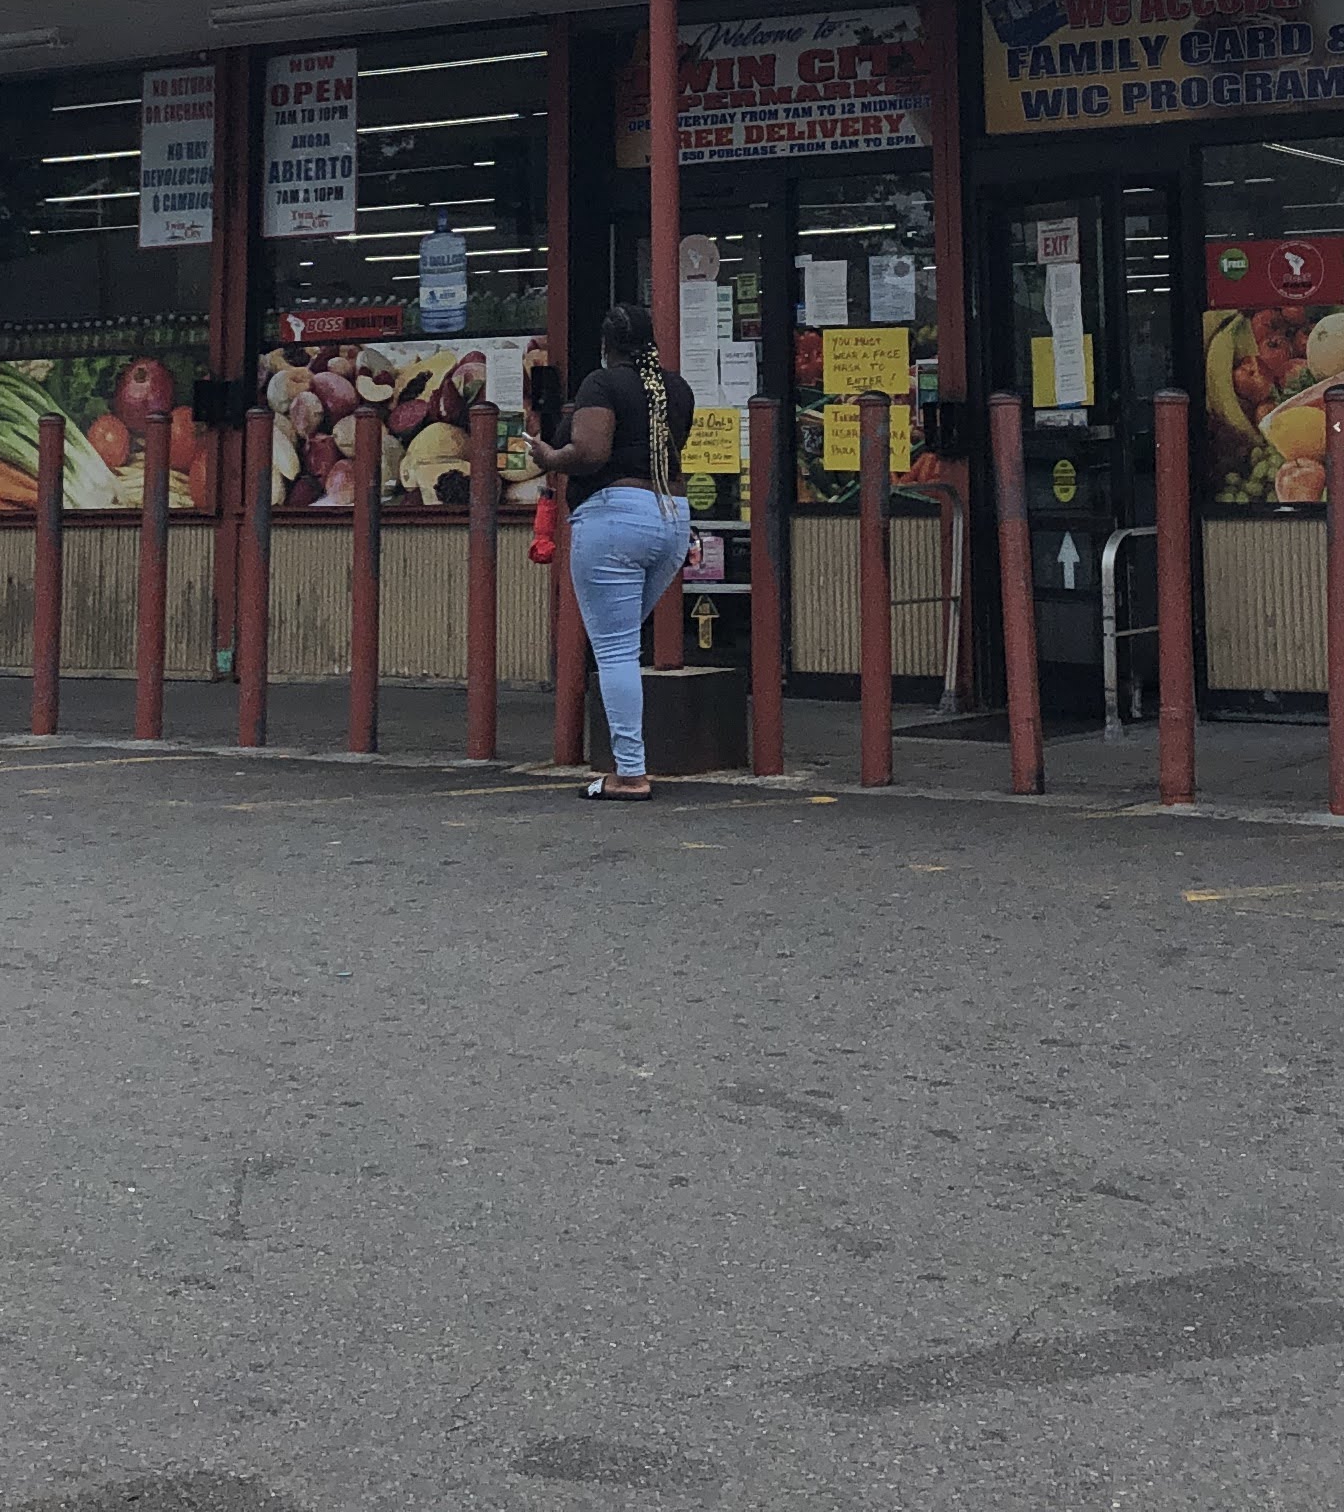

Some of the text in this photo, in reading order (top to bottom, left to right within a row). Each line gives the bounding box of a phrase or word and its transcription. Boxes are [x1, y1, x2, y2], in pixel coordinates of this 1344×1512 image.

[699, 21, 805, 52] Welcome
[290, 55, 335, 73] NOW
[797, 41, 930, 84] CITY
[1007, 33, 1169, 80] FAMILY
[1179, 22, 1313, 67] CARD
[270, 76, 353, 106] OPEN
[624, 76, 929, 118] SPERMARKET
[1021, 83, 1111, 121] WIC
[275, 105, 349, 125] 7AM TO 10PM
[628, 96, 930, 132] OPE VERYDAY FROM 7AM TO 12 MIDNIGHT
[291, 132, 331, 149] AHORA
[678, 113, 905, 150] REE DELIVERY
[167, 140, 208, 161] NO HAY
[709, 145, 776, 159] PURCHASE
[789, 141, 826, 153] FROM
[863, 137, 882, 148] TO
[268, 154, 353, 184] ABIERTO
[276, 189, 299, 205] 7AM
[313, 185, 344, 201] 10PM
[1044, 235, 1069, 257] EXIT
[306, 317, 344, 333] BOSS
[873, 349, 901, 361] FACE
